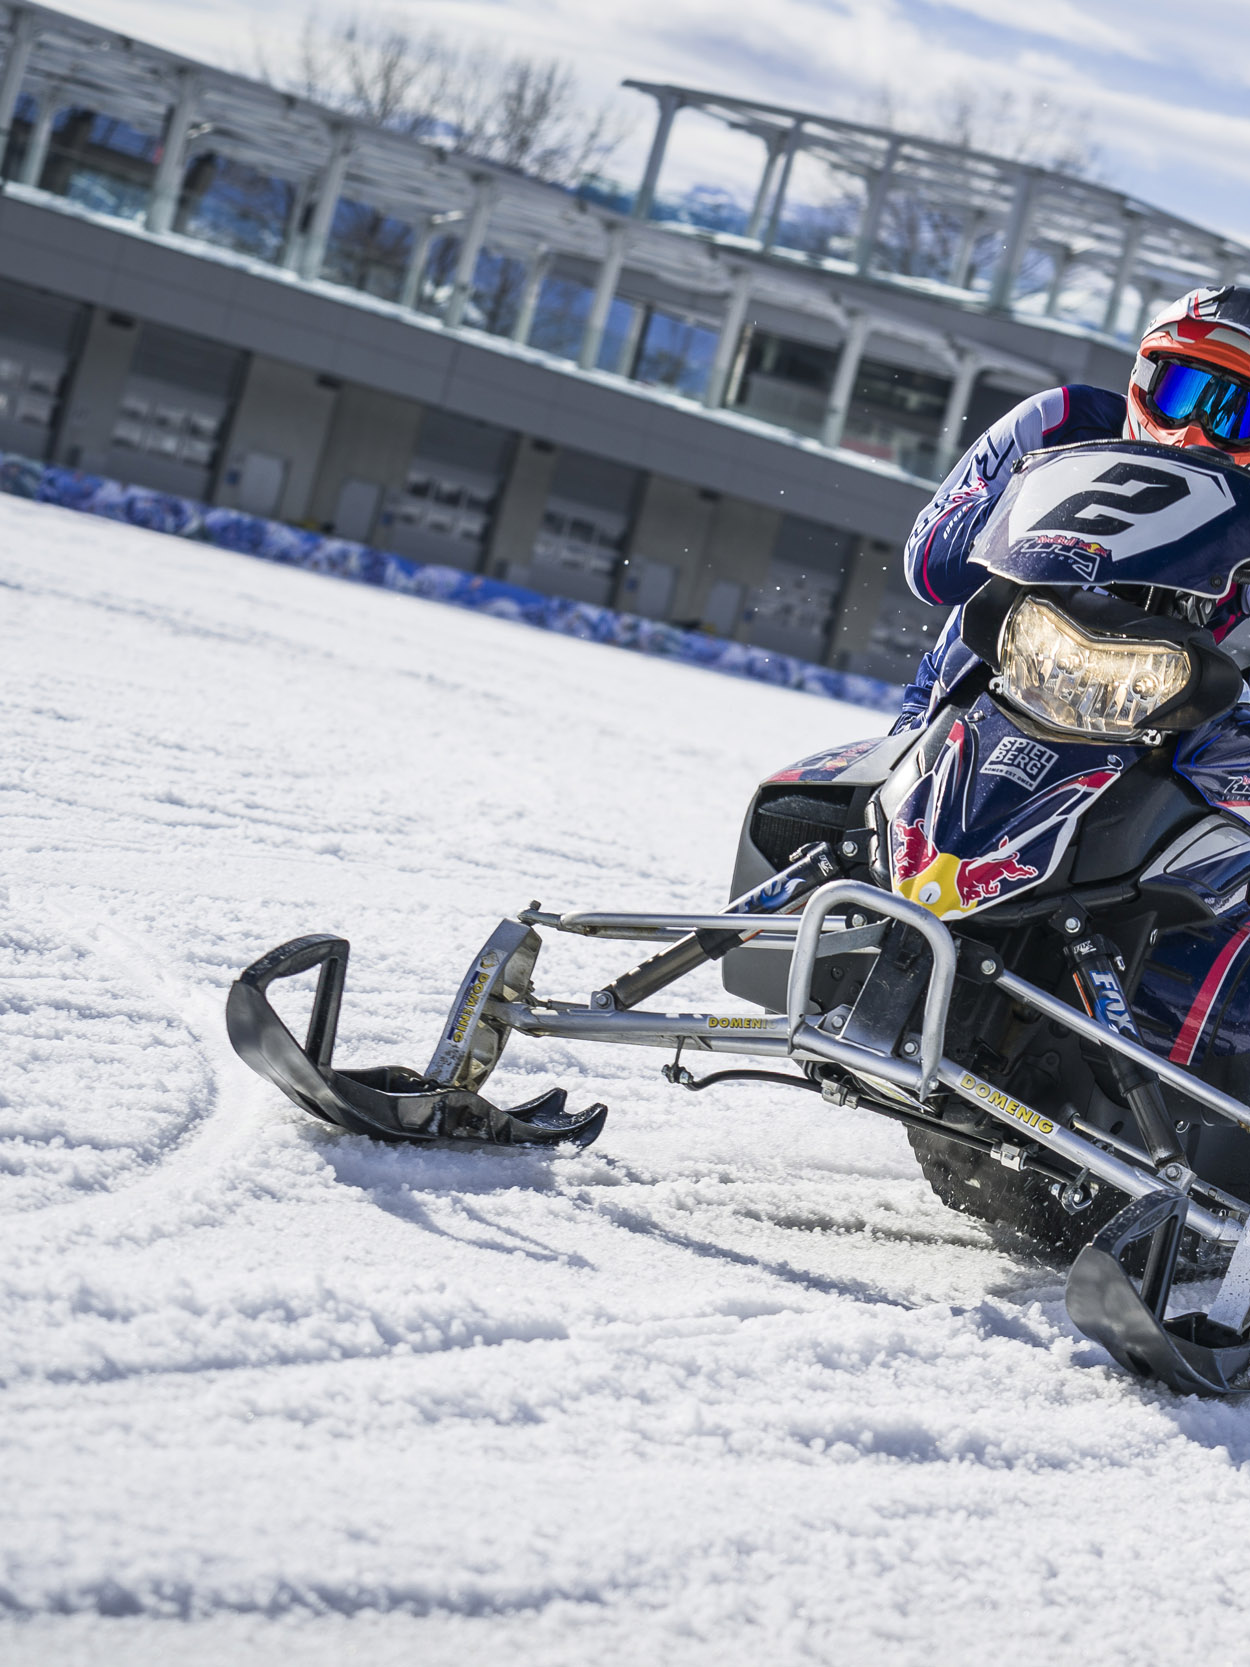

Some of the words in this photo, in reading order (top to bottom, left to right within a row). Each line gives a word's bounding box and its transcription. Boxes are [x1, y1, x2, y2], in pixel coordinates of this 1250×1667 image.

[1027, 462, 1191, 536] 2
[992, 749, 1042, 776] BERG
[999, 739, 1050, 767] SPIEL
[453, 972, 490, 1043] DOMENIG
[1091, 971, 1138, 1036] FOX
[960, 1074, 1054, 1133] DOMENIG
